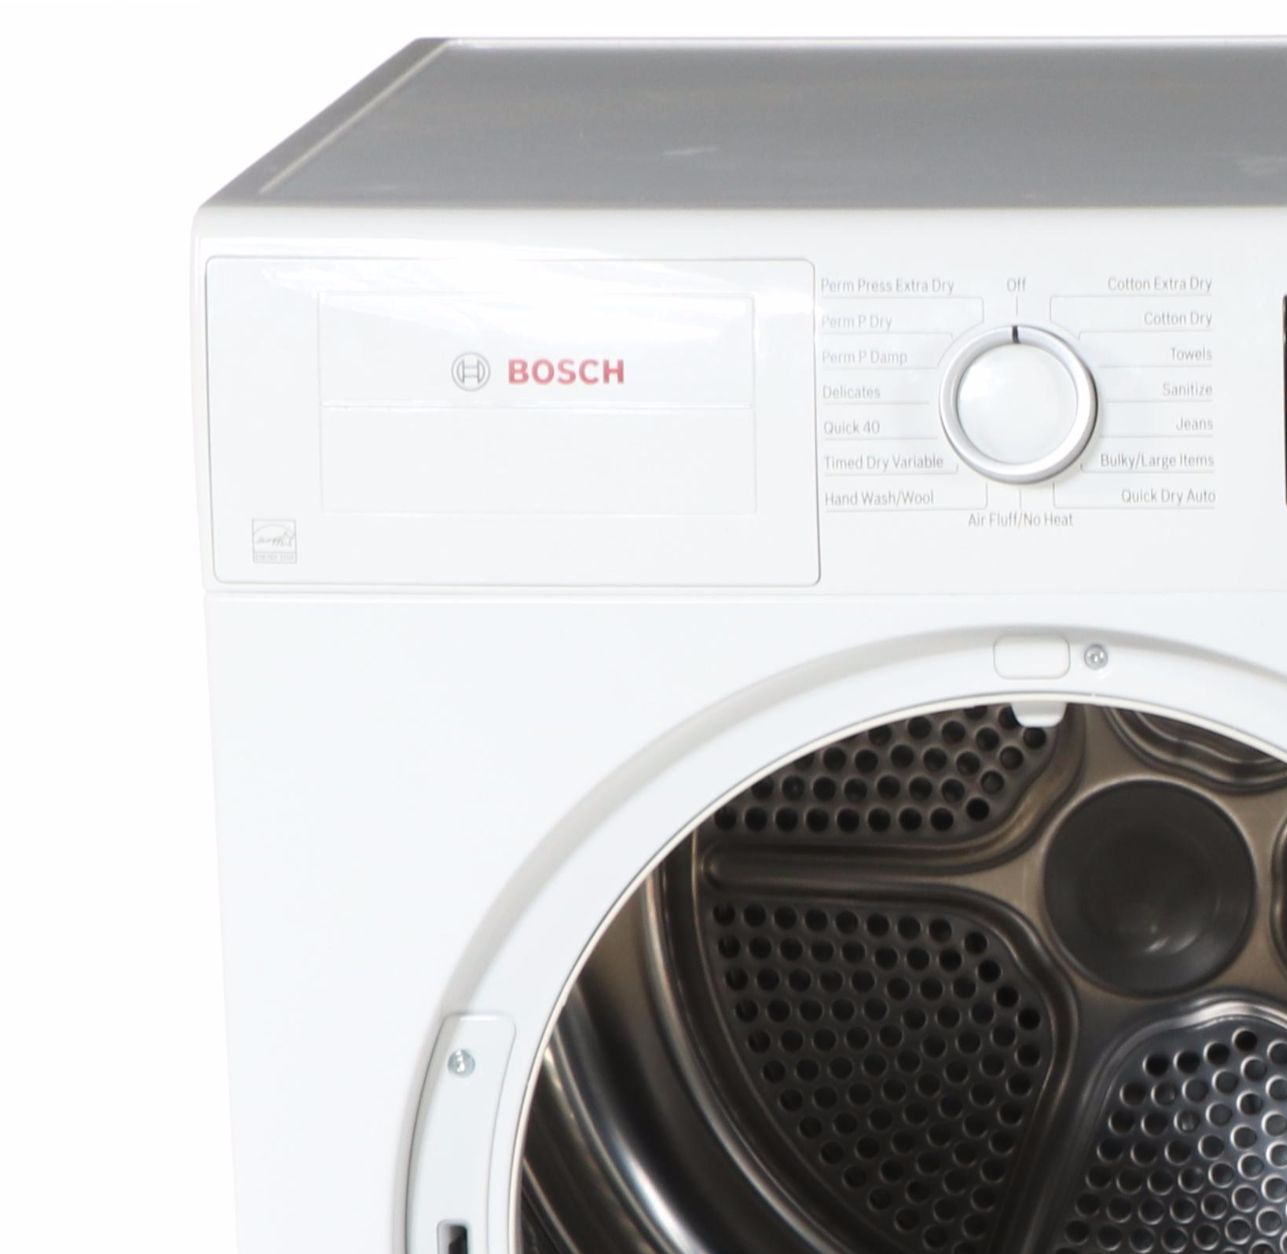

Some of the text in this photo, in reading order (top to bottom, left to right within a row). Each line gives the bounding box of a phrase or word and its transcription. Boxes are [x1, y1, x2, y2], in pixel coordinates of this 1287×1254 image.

[821, 278, 954, 295] Perm Press Extra Dry
[1007, 277, 1026, 292] Off
[1108, 276, 1212, 294] Cotton Extra Dry
[822, 314, 892, 331] Perm P Dry
[1144, 310, 1212, 328] Cotton Dry
[822, 349, 908, 366] Perm P Damp
[1170, 346, 1212, 360] Towels
[508, 359, 624, 385] BOSCH
[823, 385, 880, 399] Delicates
[1163, 382, 1212, 396] Sanitize
[824, 420, 880, 434] Quick 40
[1176, 416, 1213, 431] Jeans
[824, 454, 944, 473] Timed Dry Variable
[1101, 453, 1214, 471] Bulky/Large Items
[825, 490, 934, 507] Hand Wash/Wool
[1121, 488, 1216, 505] Quick Dry Auto
[968, 512, 1072, 528] Air Fluff/No Heat
